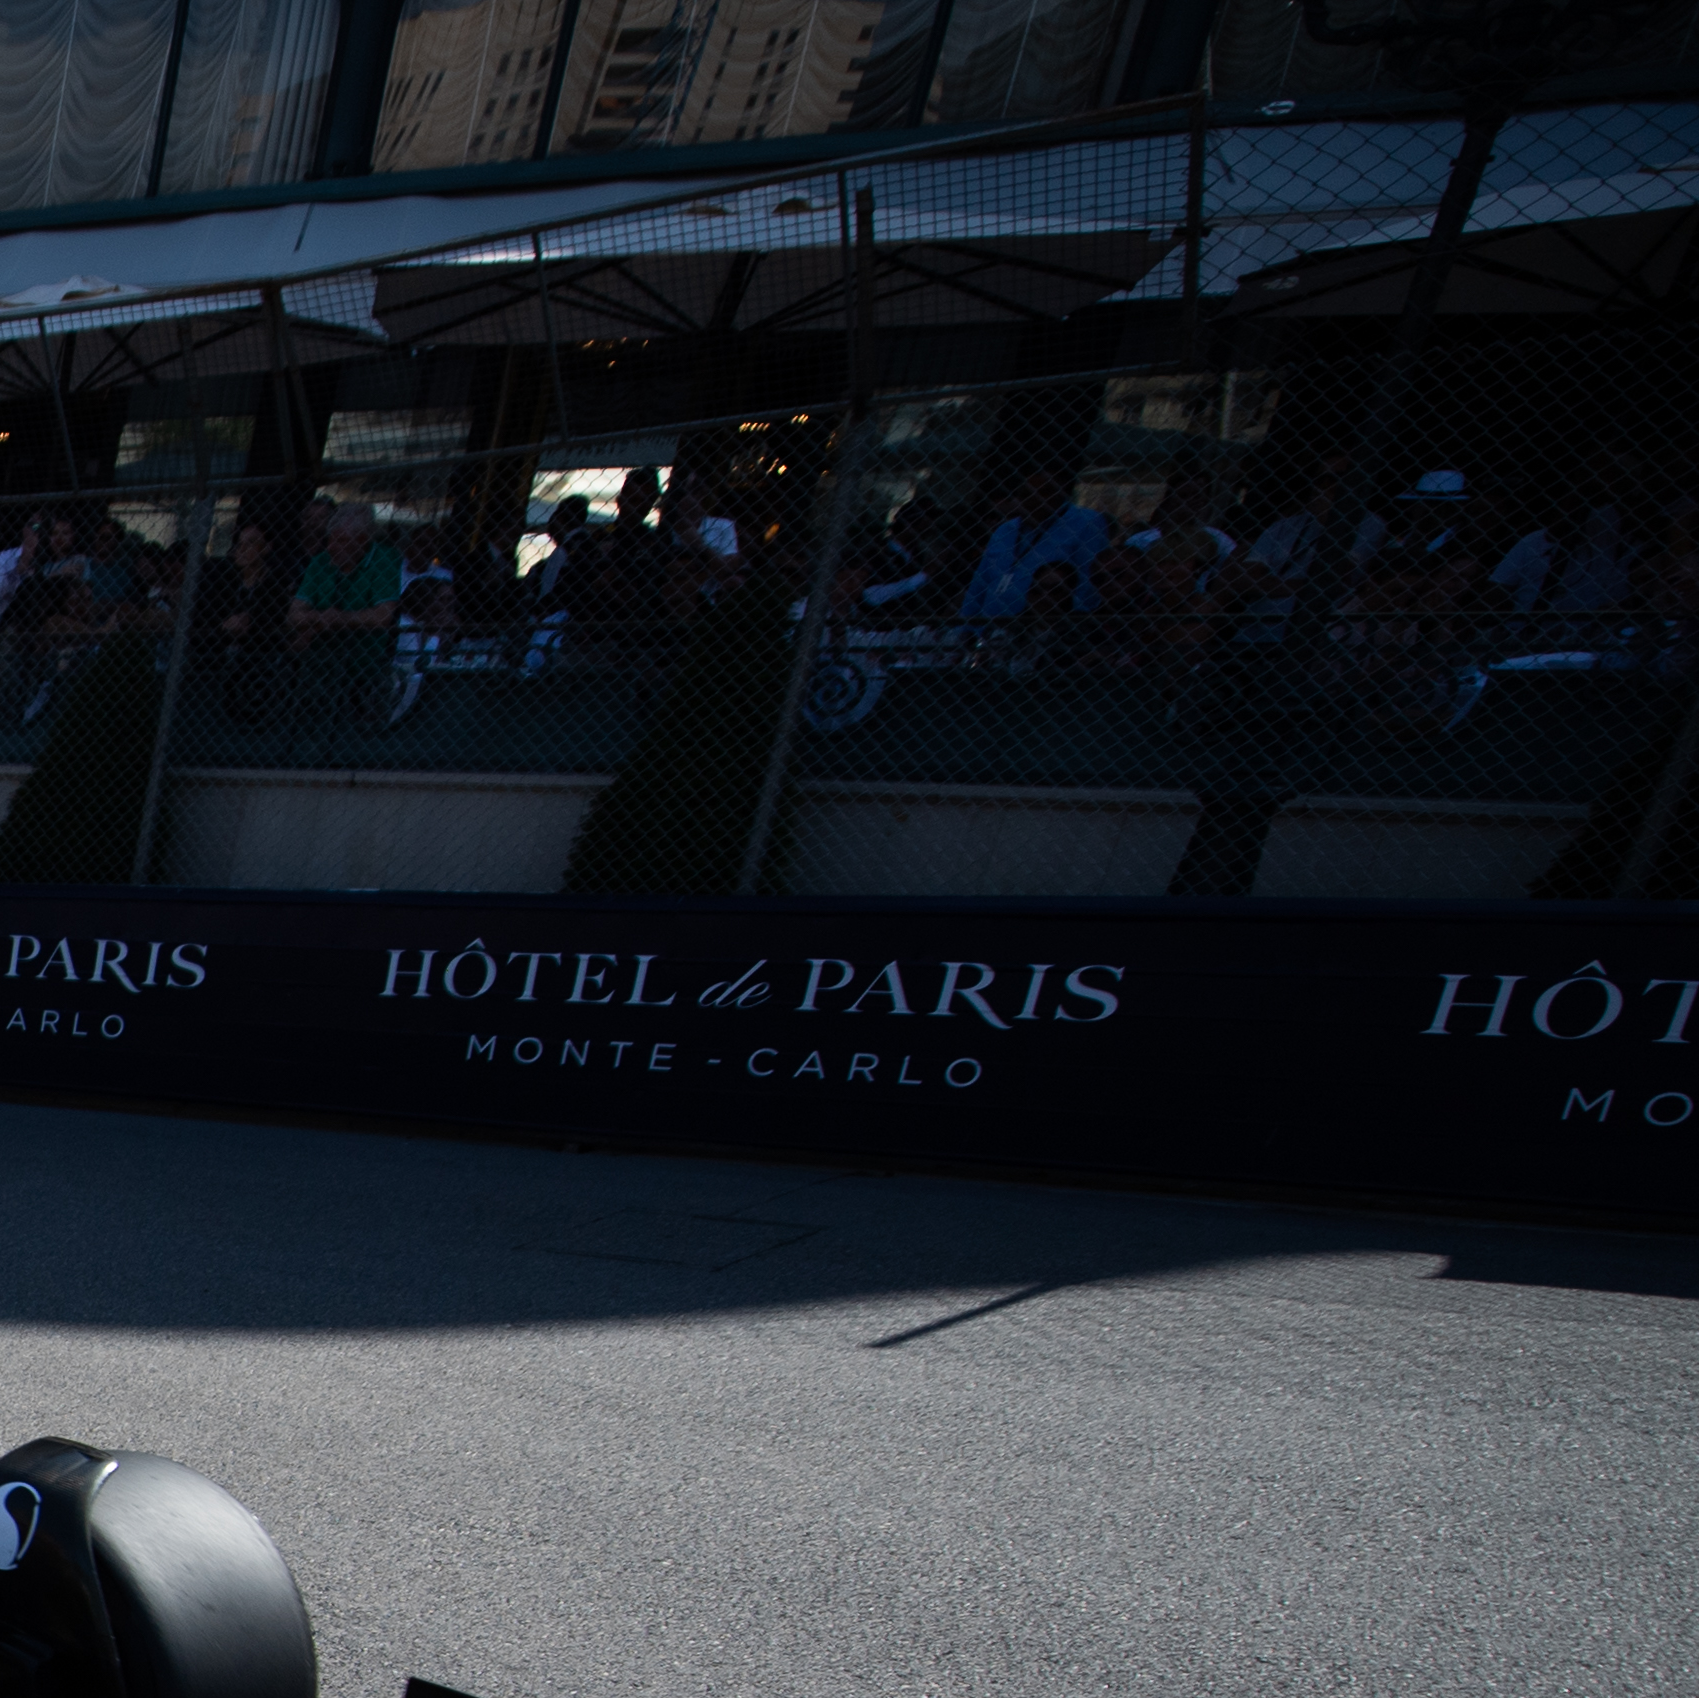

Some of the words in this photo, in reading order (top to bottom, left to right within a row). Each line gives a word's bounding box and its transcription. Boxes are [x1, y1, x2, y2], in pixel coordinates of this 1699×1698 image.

[4, 933, 209, 995] PARIS
[376, 937, 680, 1007] HÔTEL
[696, 957, 773, 1010] de
[794, 956, 1127, 1031] PARIS
